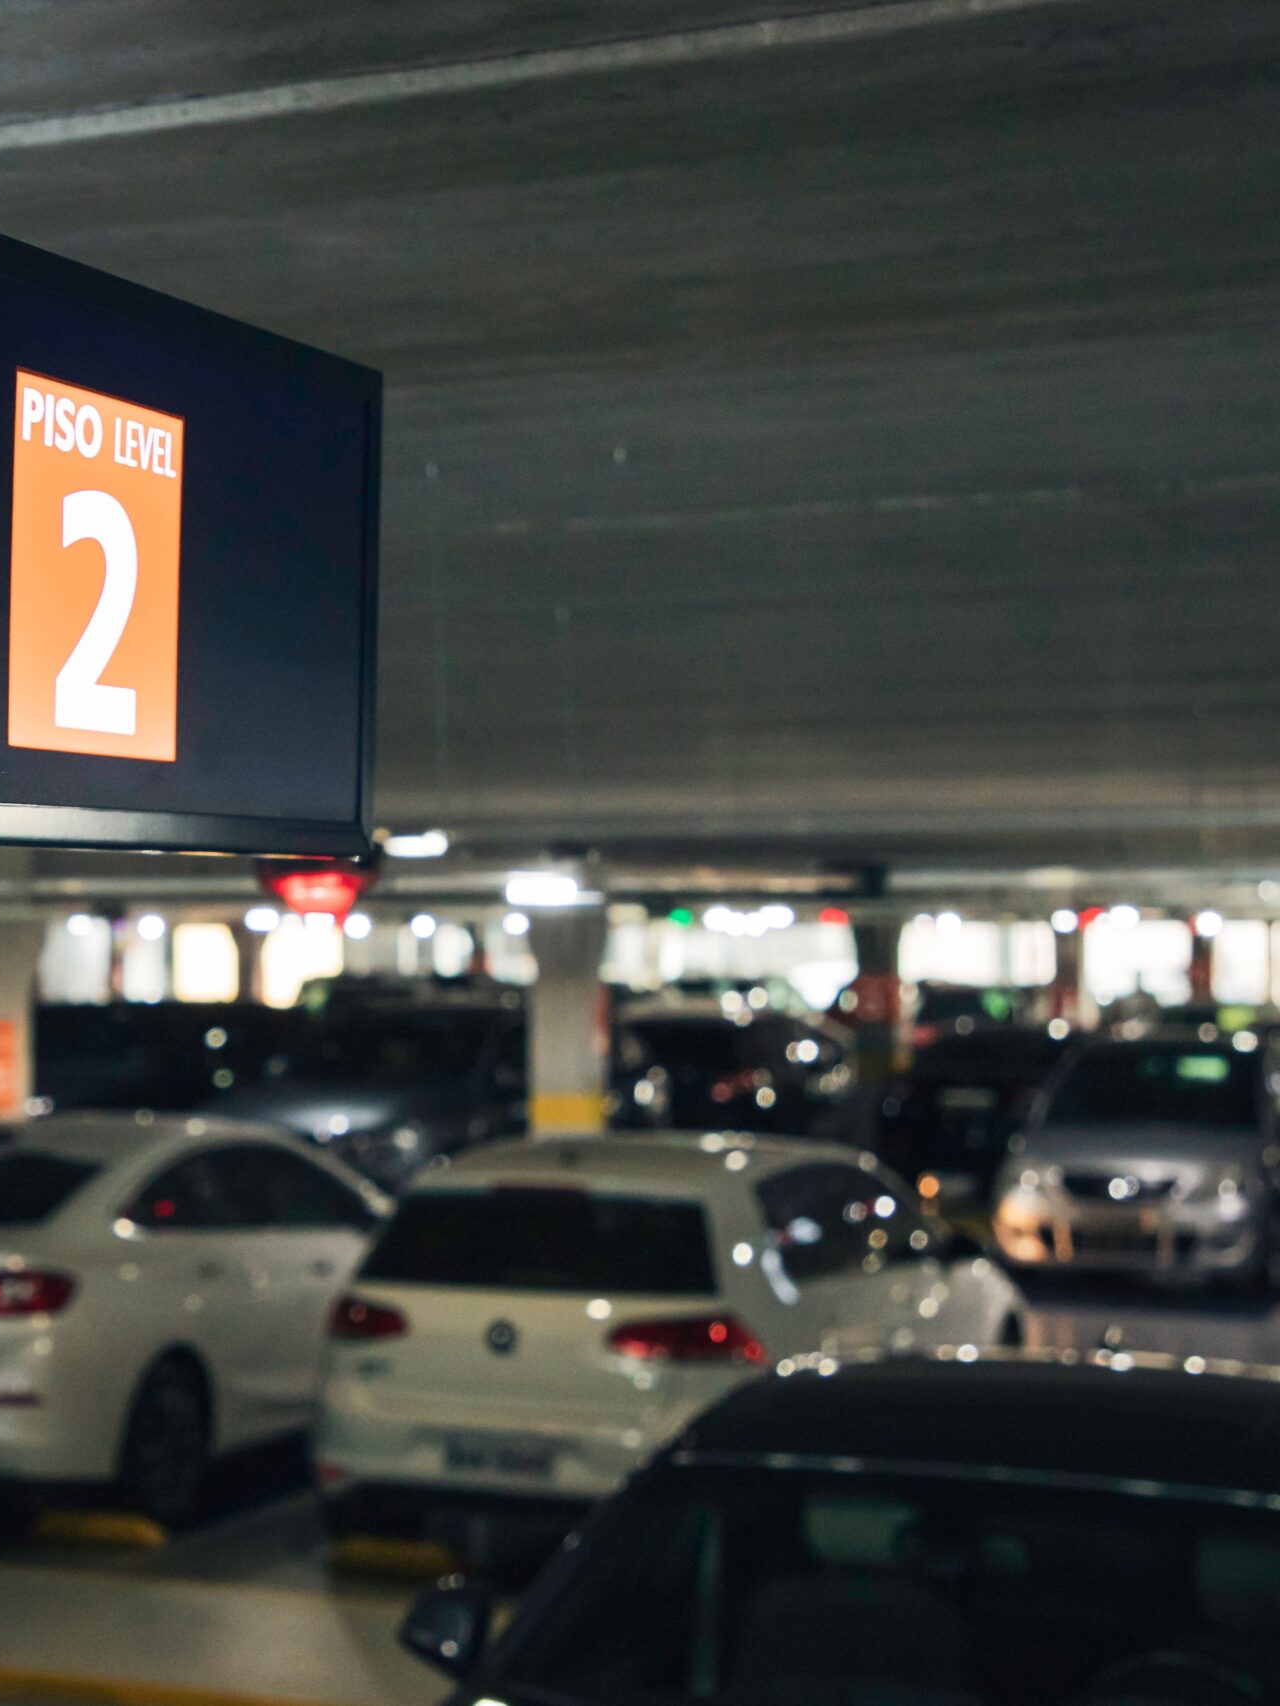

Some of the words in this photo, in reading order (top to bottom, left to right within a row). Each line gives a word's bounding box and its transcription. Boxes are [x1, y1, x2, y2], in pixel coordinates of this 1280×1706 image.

[22, 387, 103, 458] PISO
[114, 417, 176, 478] LEVEL
[54, 490, 137, 735] 2
